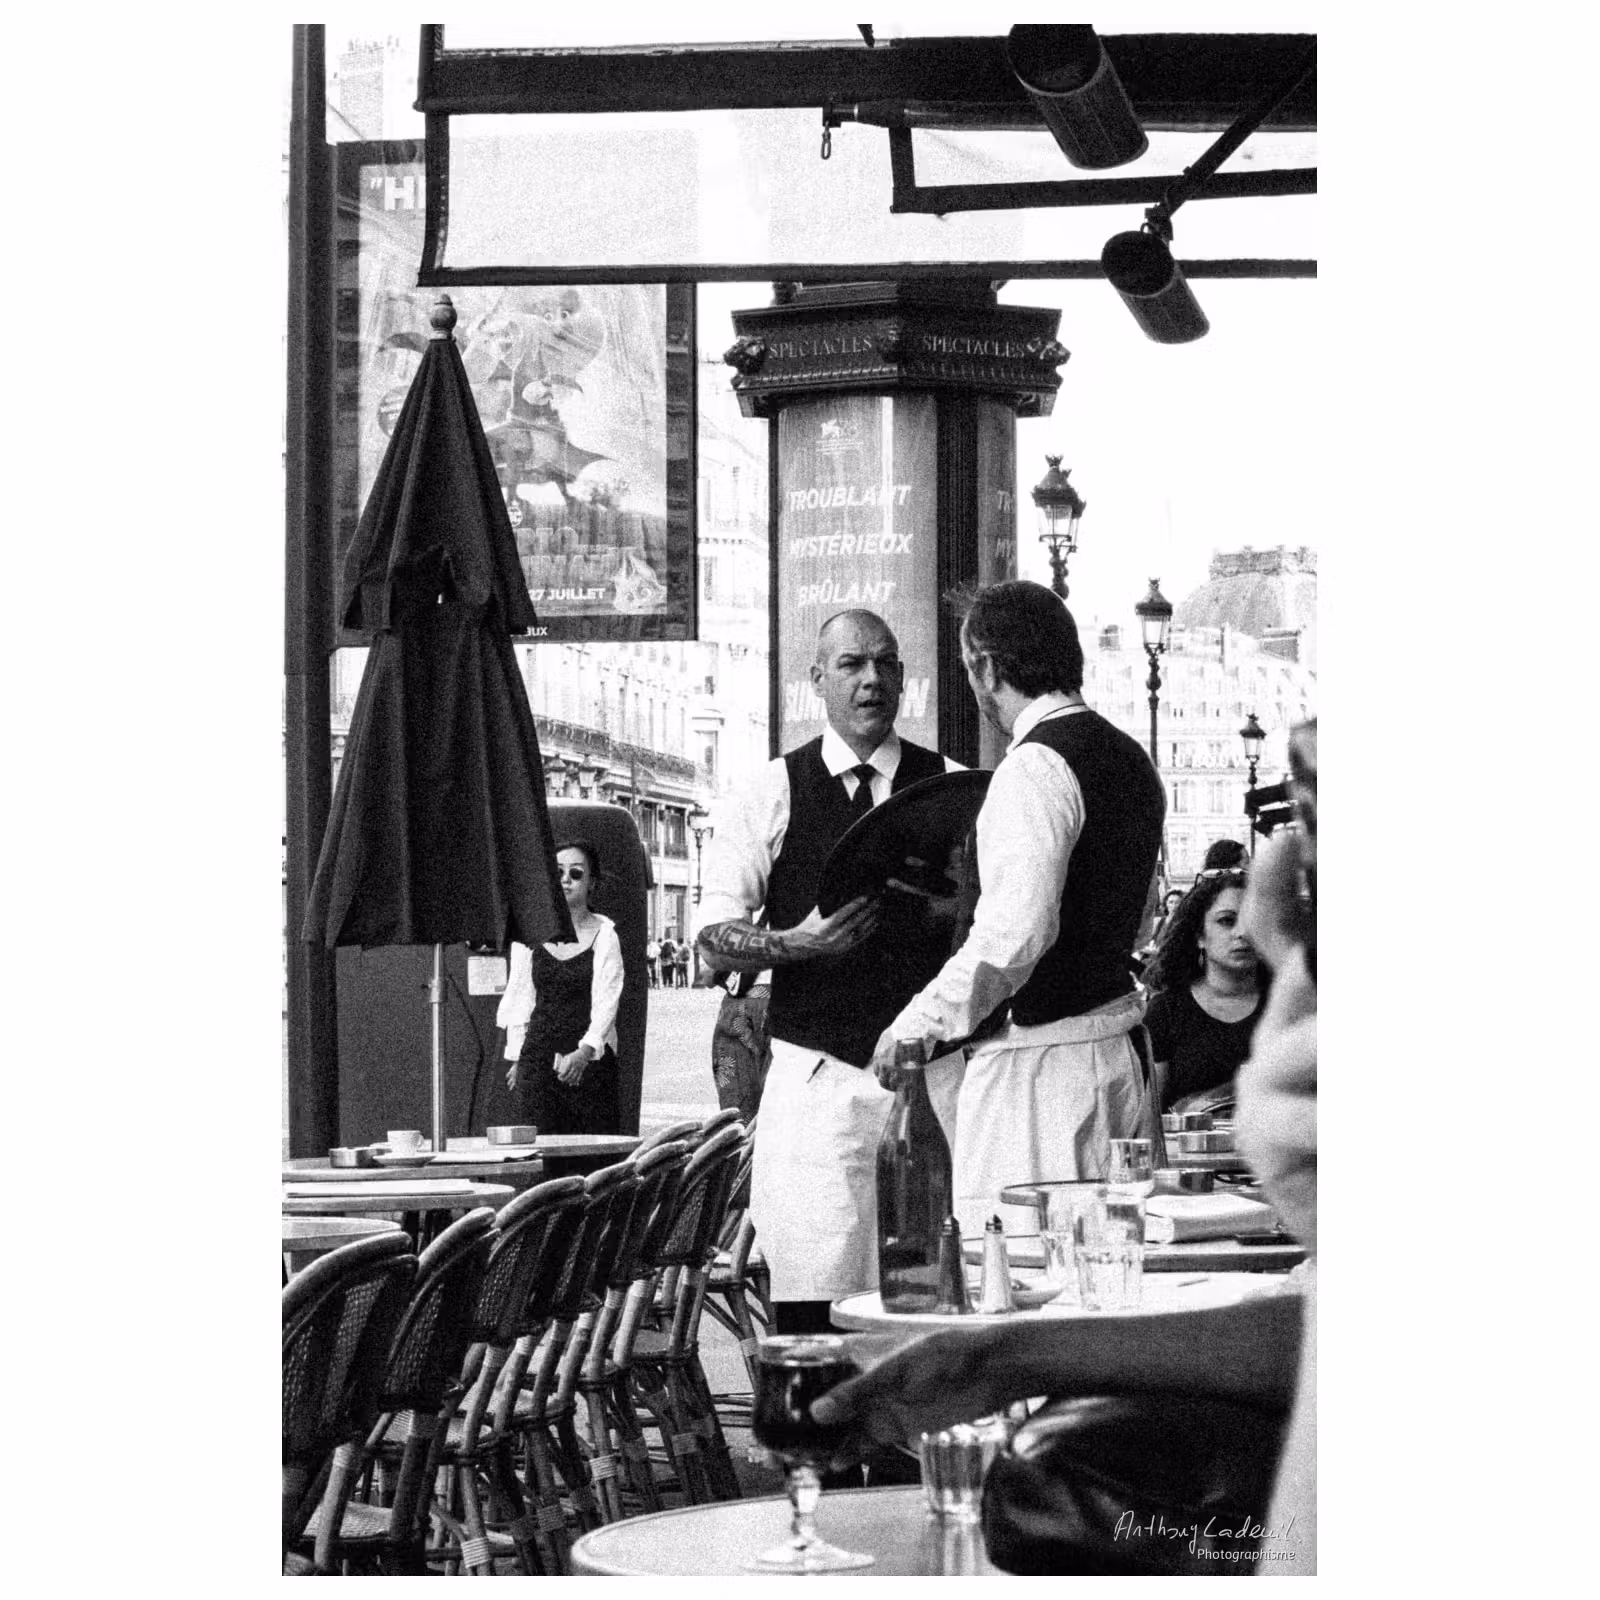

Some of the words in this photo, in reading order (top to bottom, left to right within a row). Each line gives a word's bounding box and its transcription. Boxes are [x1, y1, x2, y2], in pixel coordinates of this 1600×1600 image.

[768, 336, 873, 359] SPECTACLES
[922, 335, 1025, 358] SPECTACLES
[547, 587, 606, 601] JUILLET
